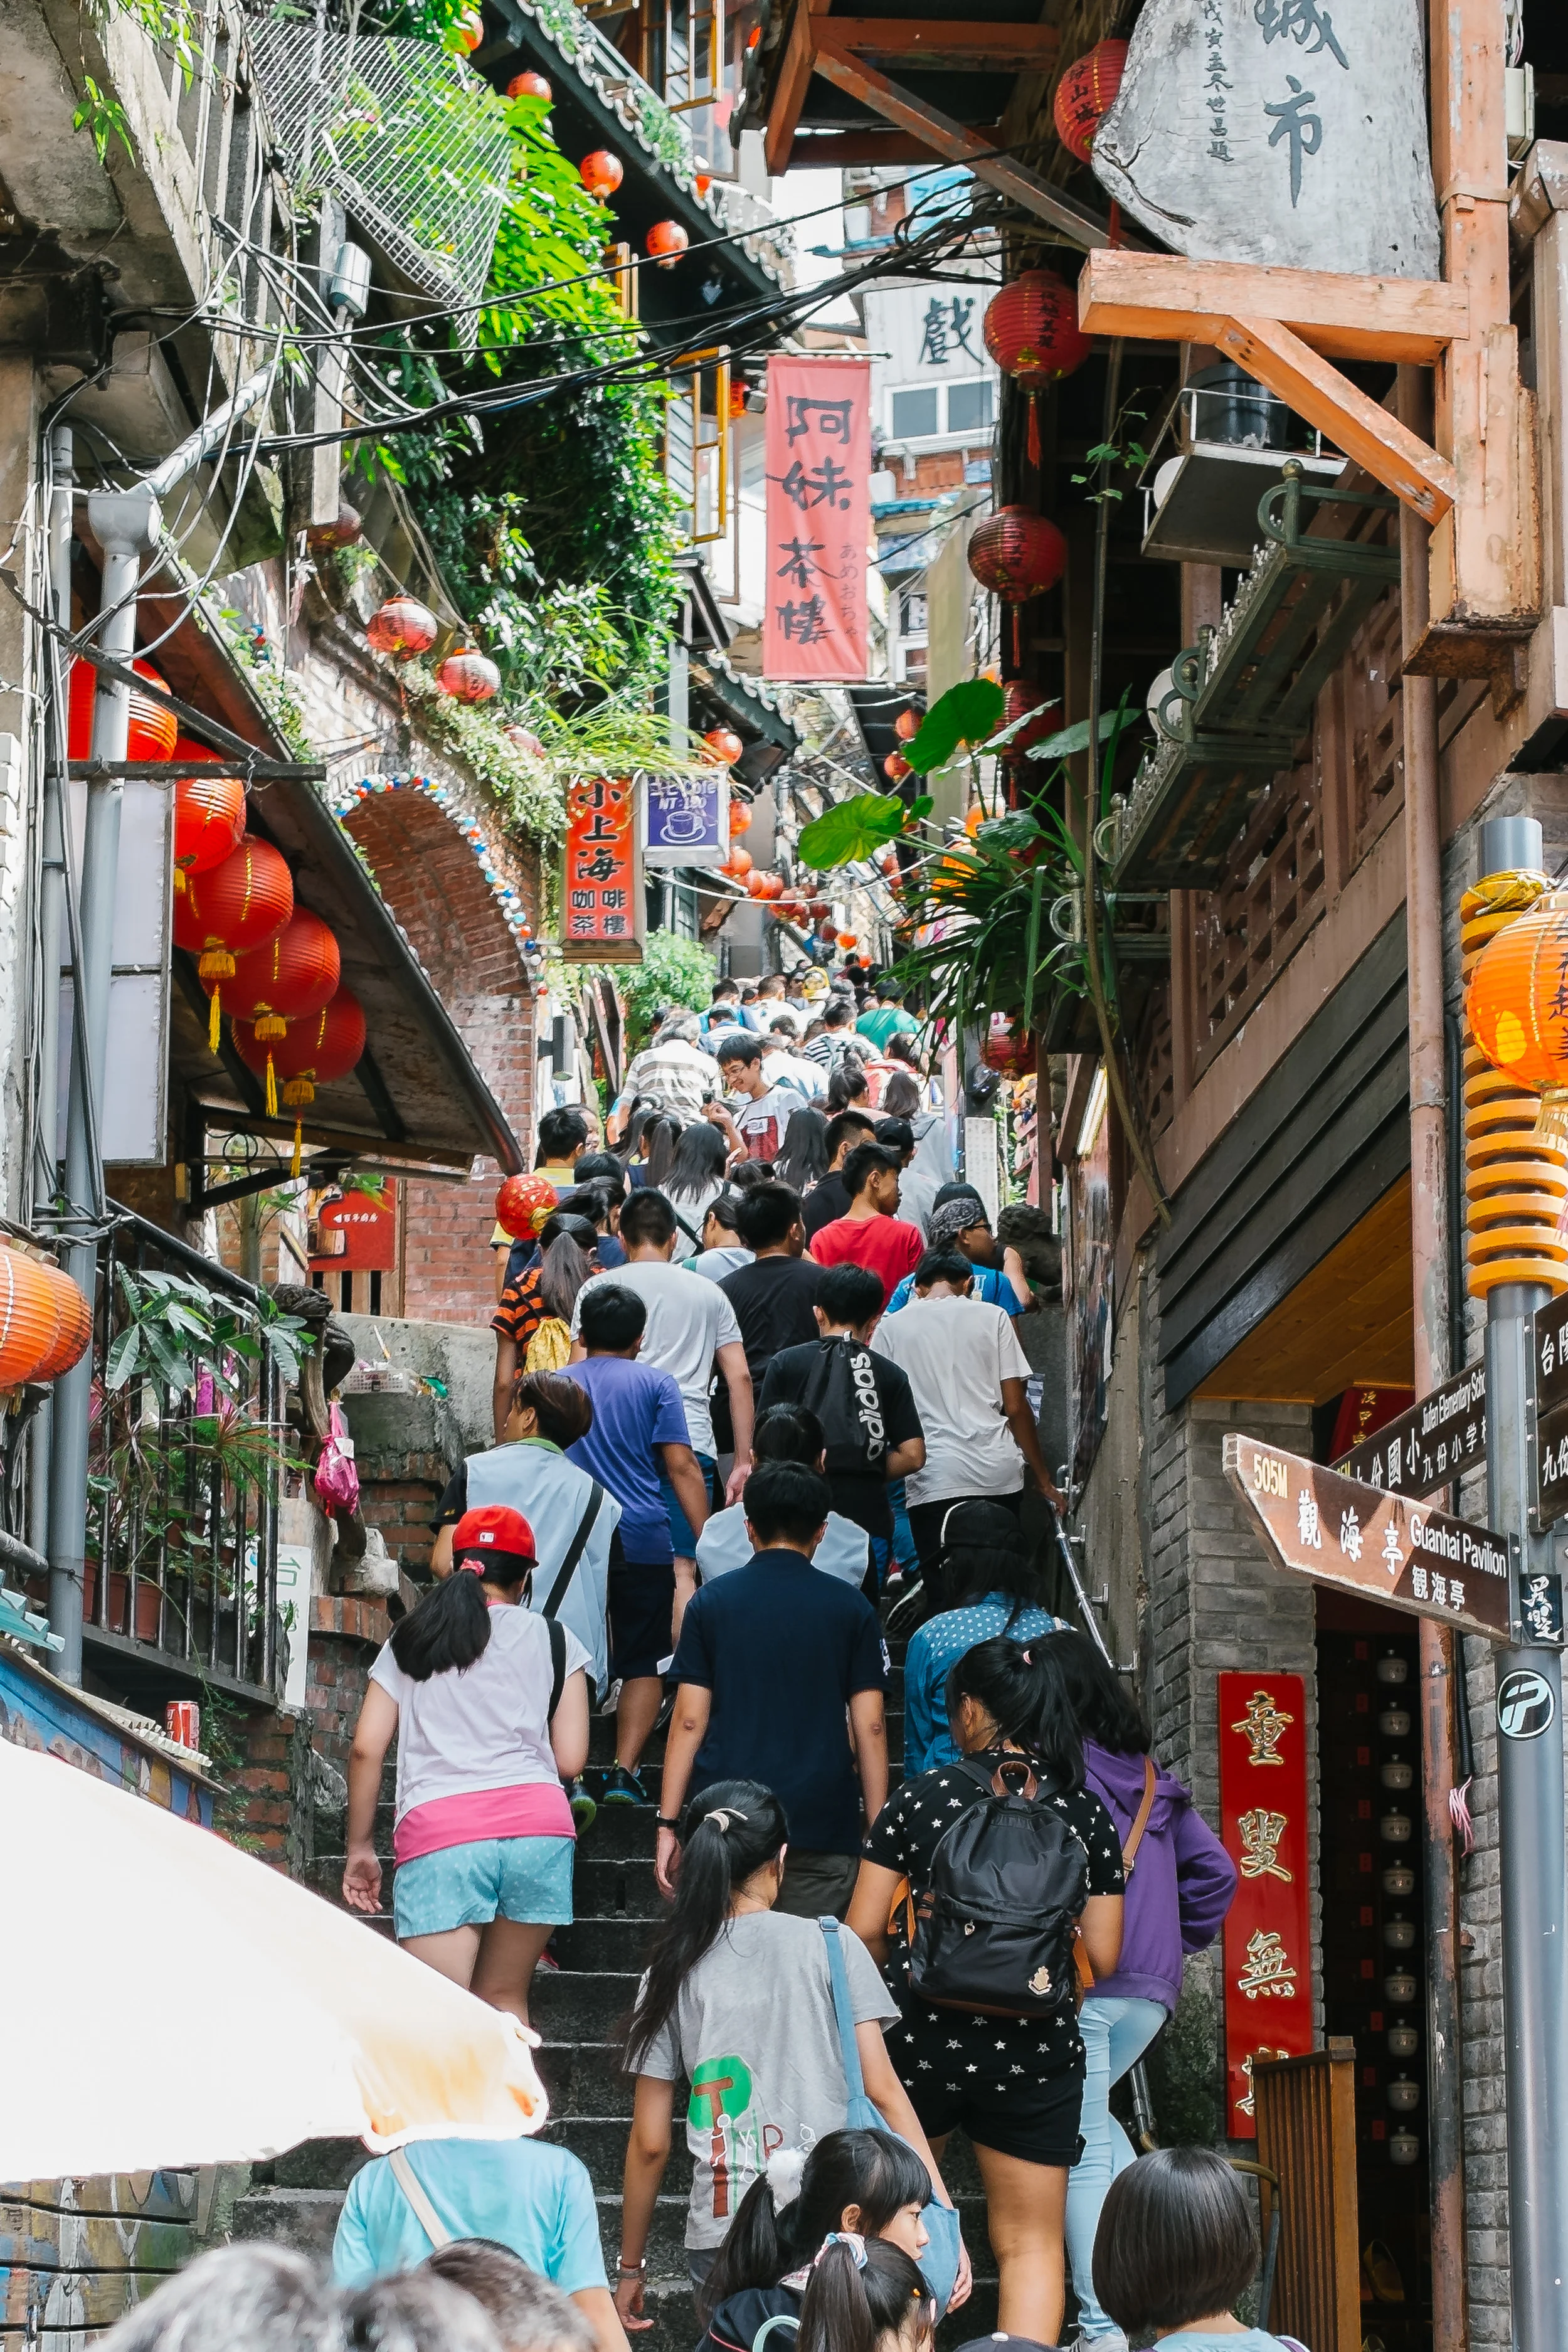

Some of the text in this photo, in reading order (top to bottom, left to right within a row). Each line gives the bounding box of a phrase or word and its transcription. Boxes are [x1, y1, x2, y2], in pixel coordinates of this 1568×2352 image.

[766, 395, 854, 645] 阿妹茶樓
[577, 782, 626, 882] 小上海
[850, 1352, 884, 1461] adidas
[1253, 1453, 1288, 1499] 505M
[1411, 1513, 1507, 1579] Guanhai Pavilion
[1231, 1690, 1295, 2117] 童叟無
